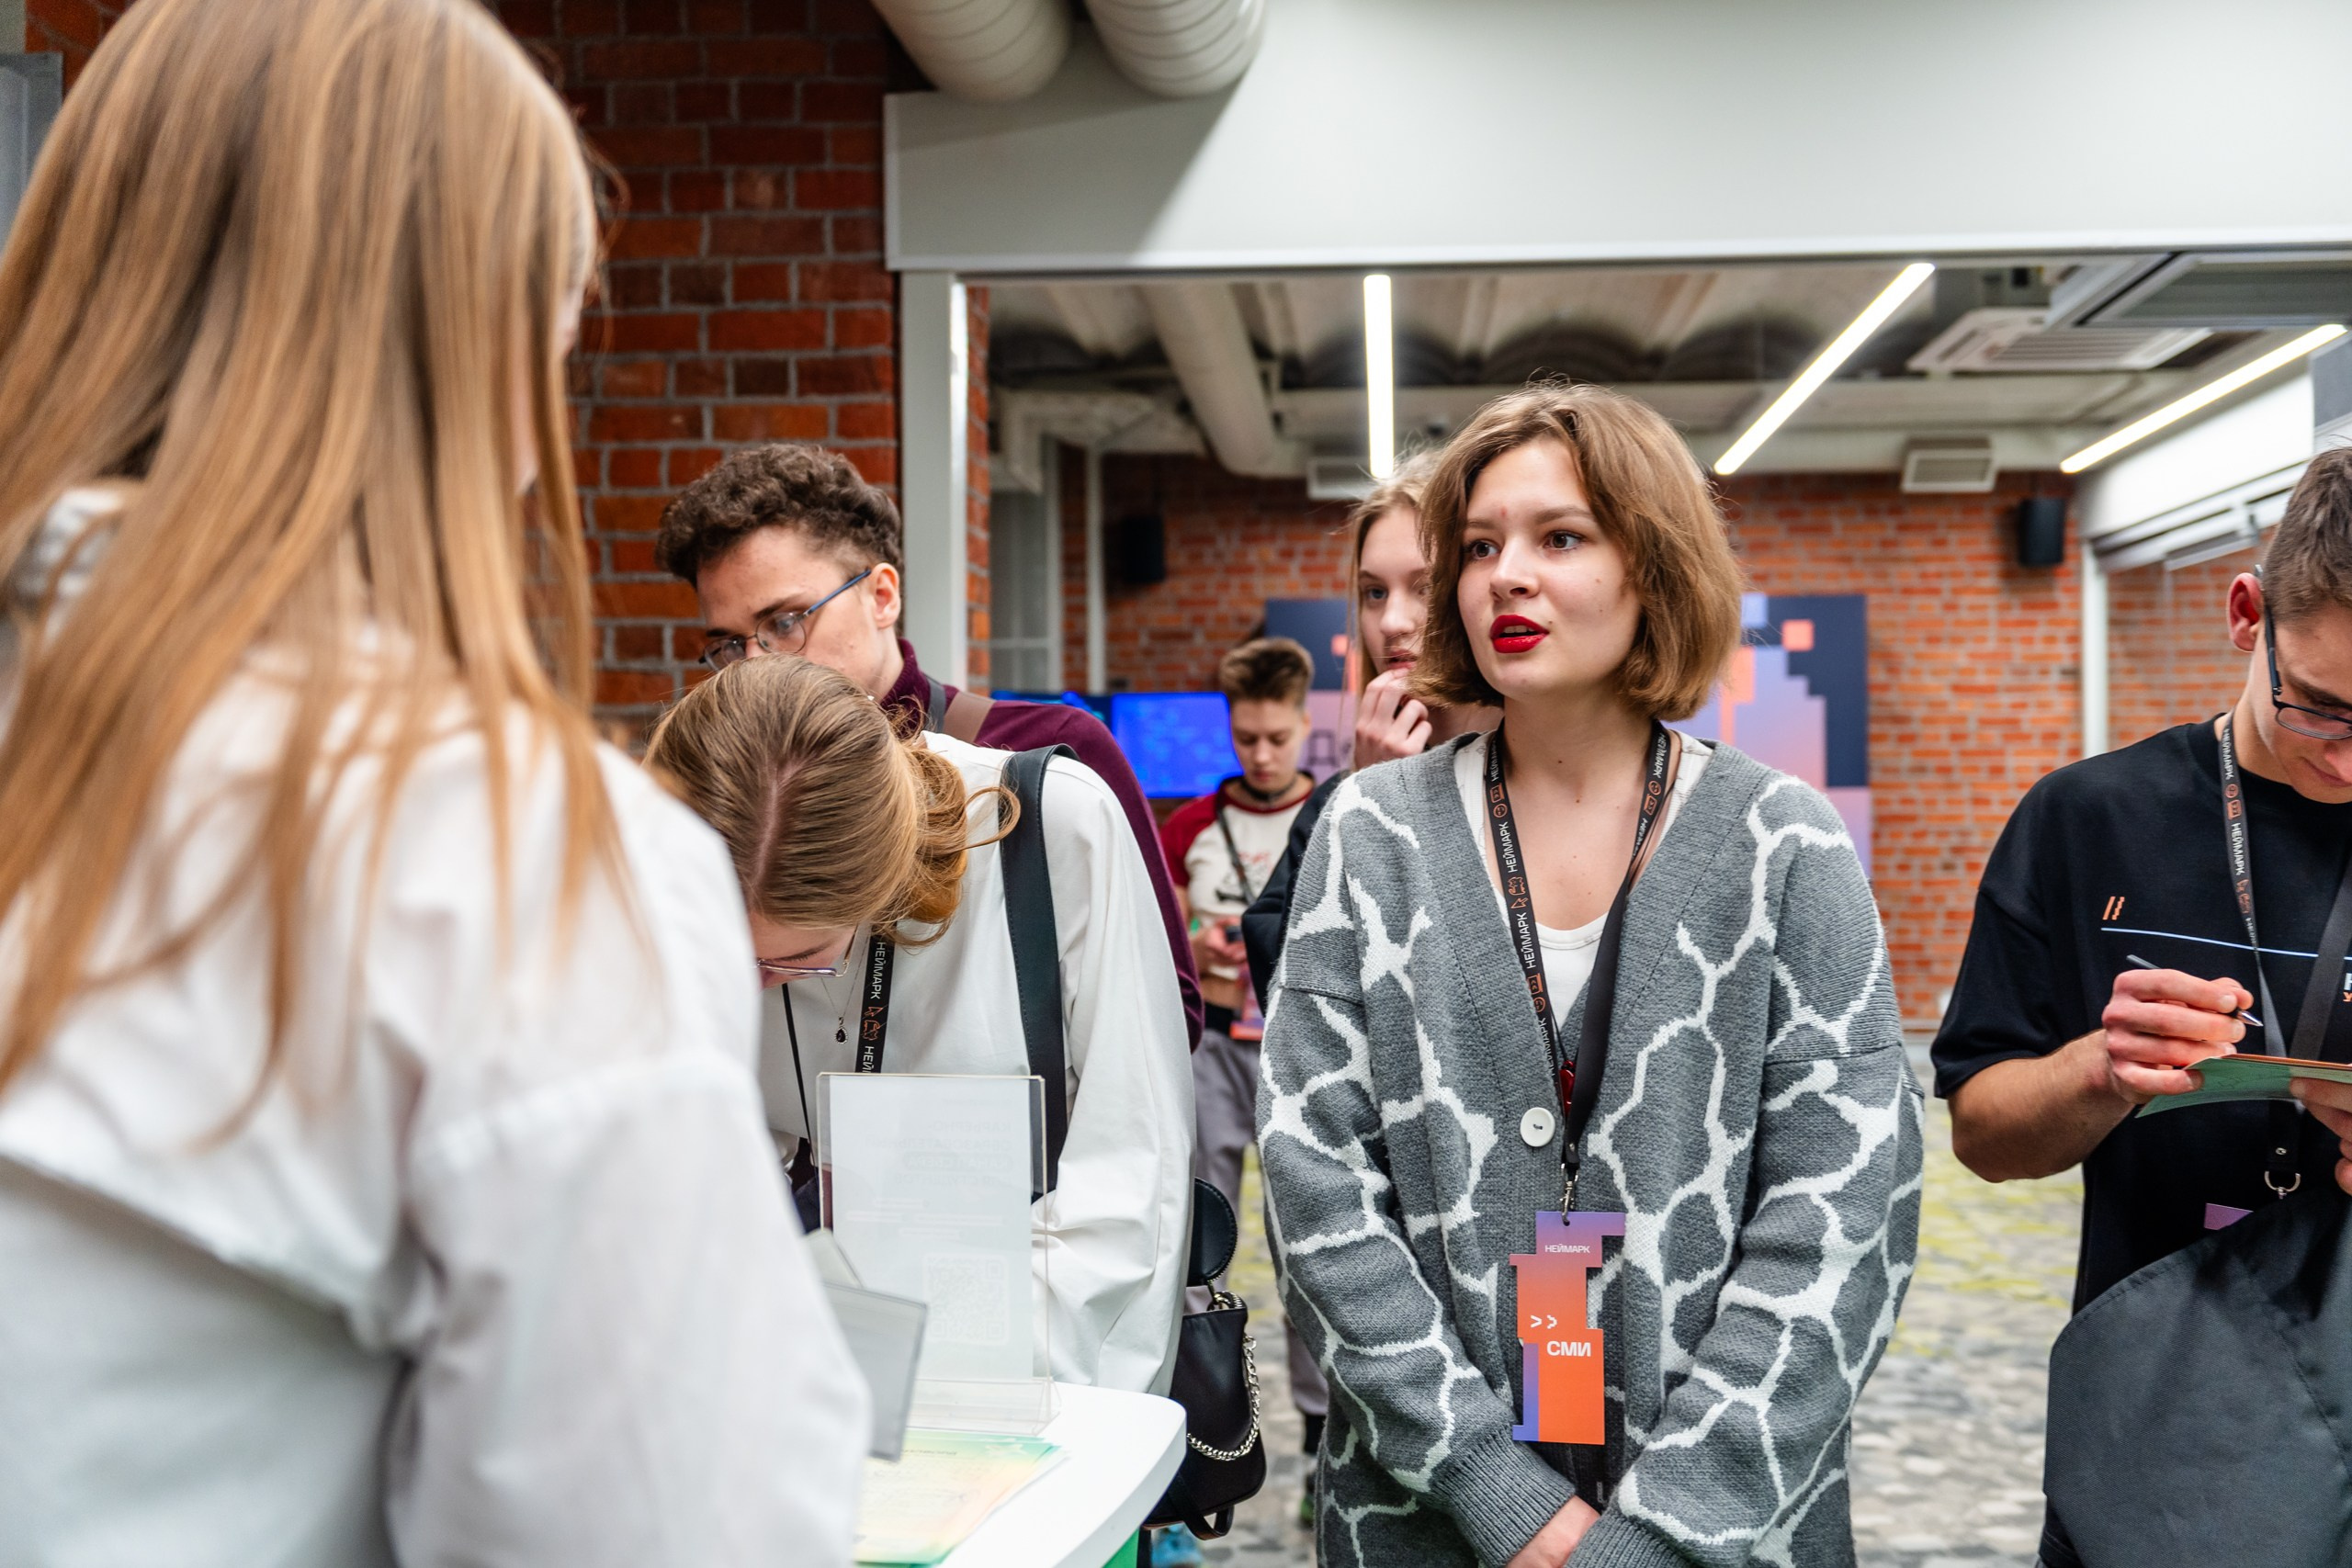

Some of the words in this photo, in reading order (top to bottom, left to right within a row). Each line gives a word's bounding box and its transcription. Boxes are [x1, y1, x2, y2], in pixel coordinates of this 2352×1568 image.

[1498, 821, 1518, 874] НЕЙМАРК
[2231, 822, 2245, 875] НЕЙМАРК
[1517, 912, 1537, 969] НЕЙМАРК
[869, 942, 887, 999] НЕЙМАРК
[1544, 1243, 1590, 1254] НЕЙМАРК
[1546, 1340, 1591, 1357] СМИ
